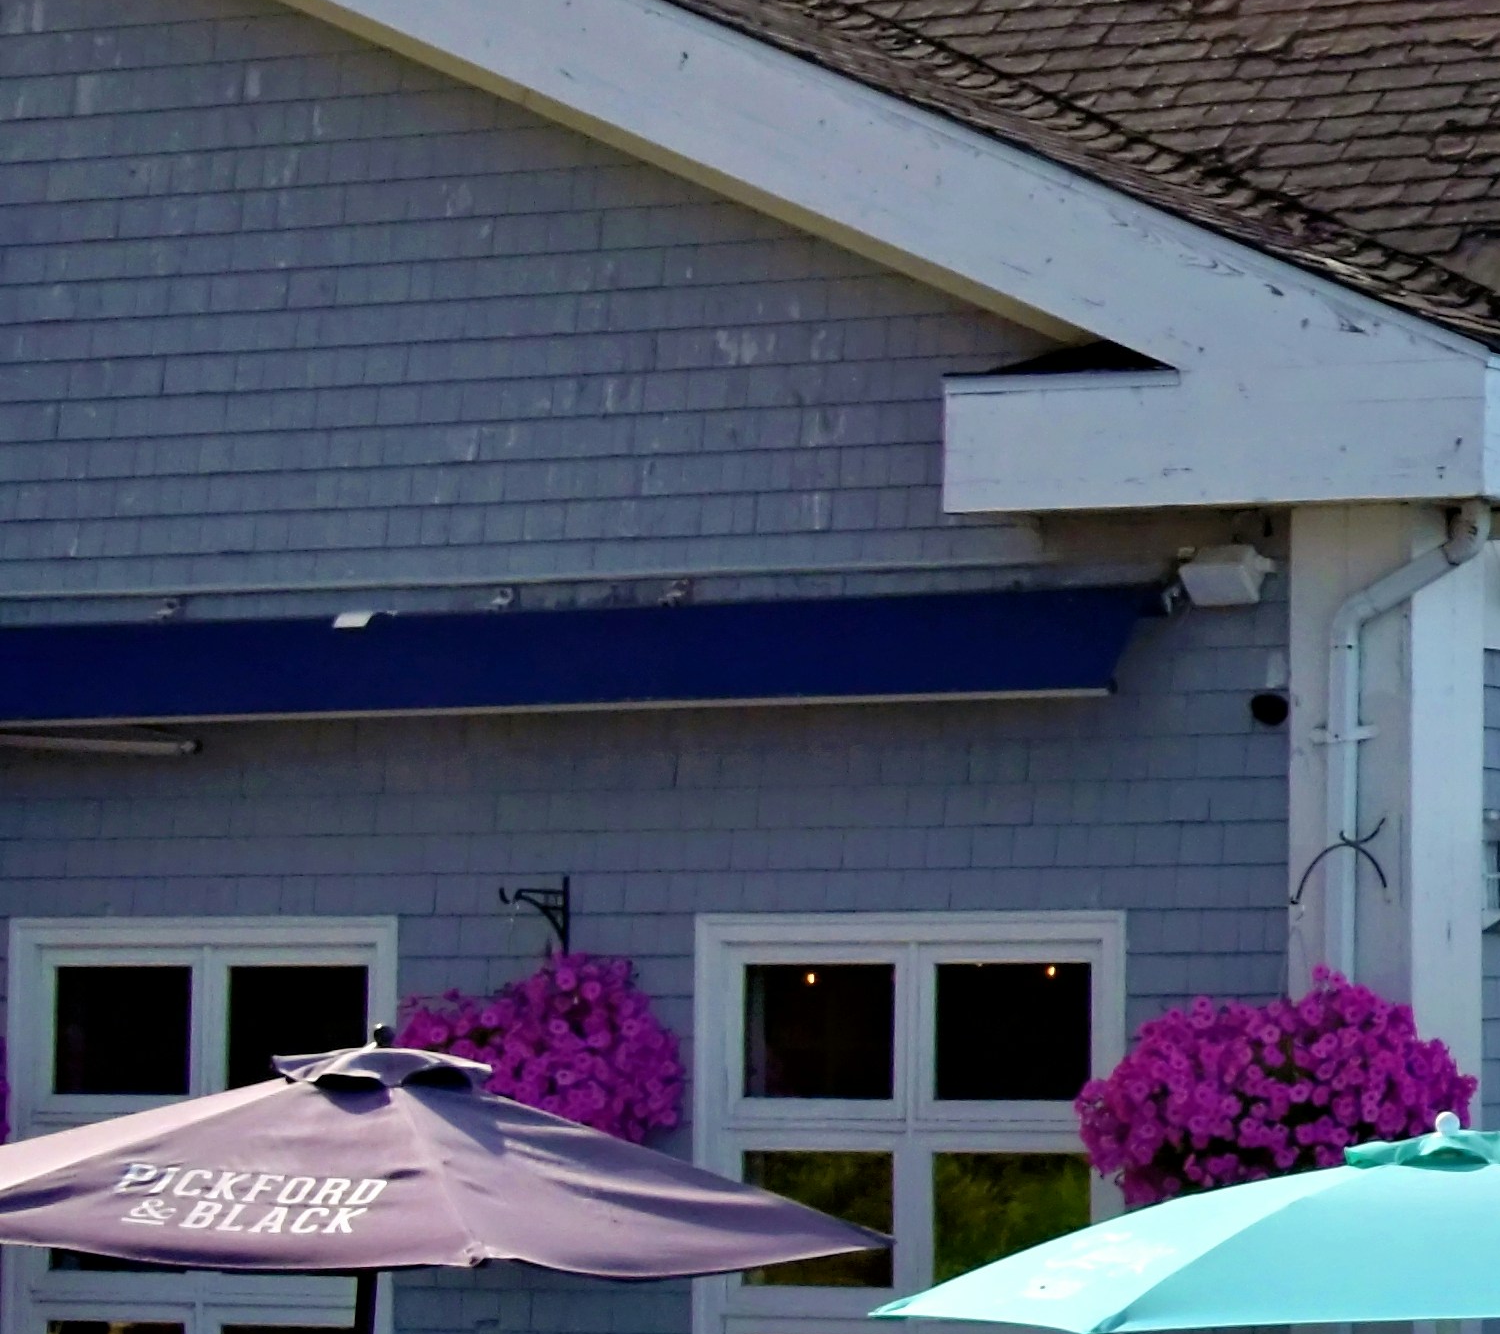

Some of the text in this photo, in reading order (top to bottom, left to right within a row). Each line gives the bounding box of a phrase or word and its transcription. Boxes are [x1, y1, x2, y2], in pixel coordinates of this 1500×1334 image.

[113, 1163, 388, 1205] PICKFORD
[121, 1198, 368, 1234] & BLACK
